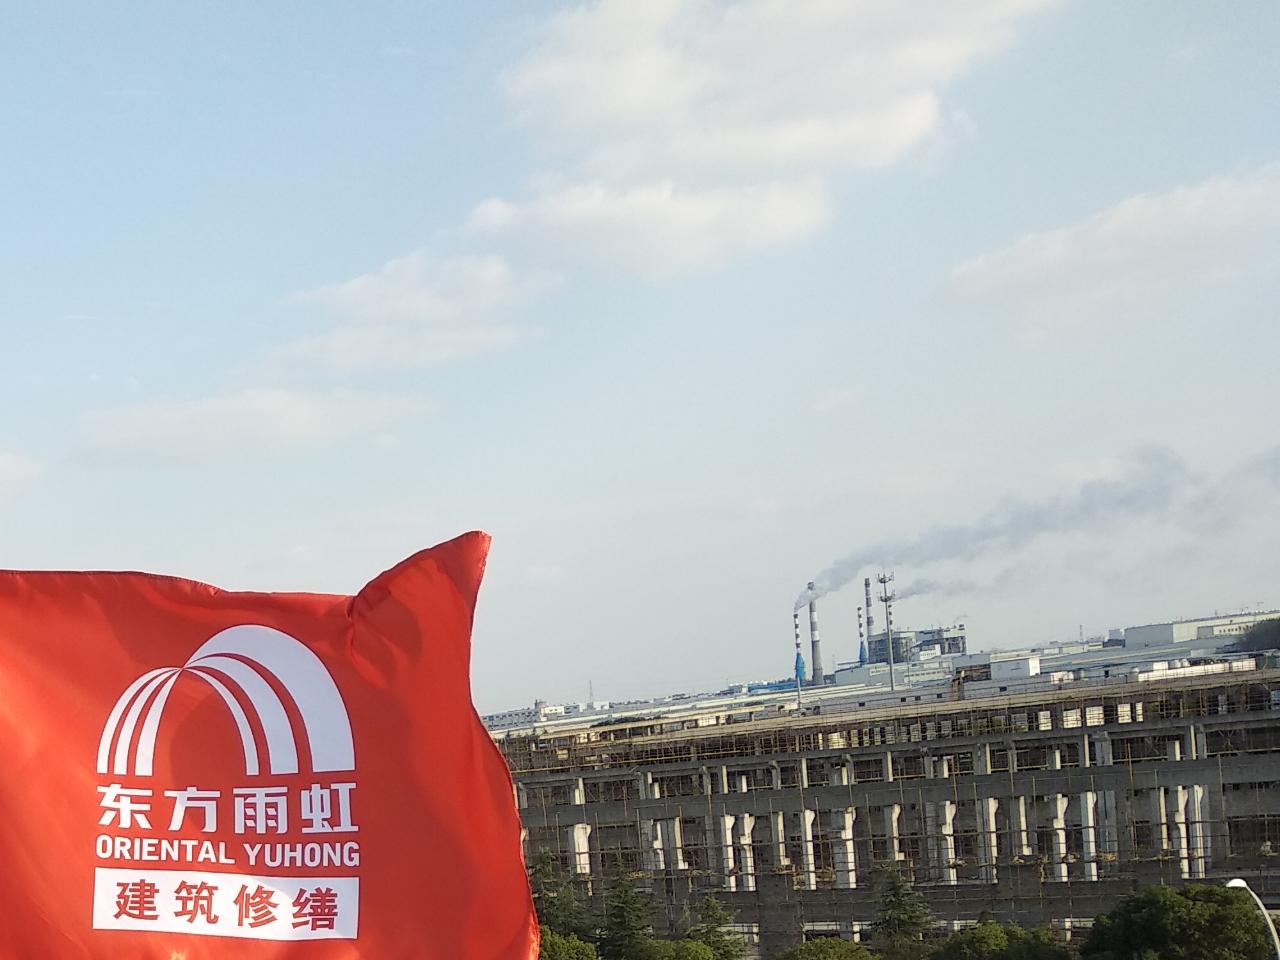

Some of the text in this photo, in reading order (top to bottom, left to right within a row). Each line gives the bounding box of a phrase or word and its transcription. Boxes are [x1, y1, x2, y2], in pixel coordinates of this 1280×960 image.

[96, 782, 360, 834] 东方雨虹
[95, 834, 360, 868] ORIENTAL YUHONG
[113, 878, 339, 931] 建筑修缮
